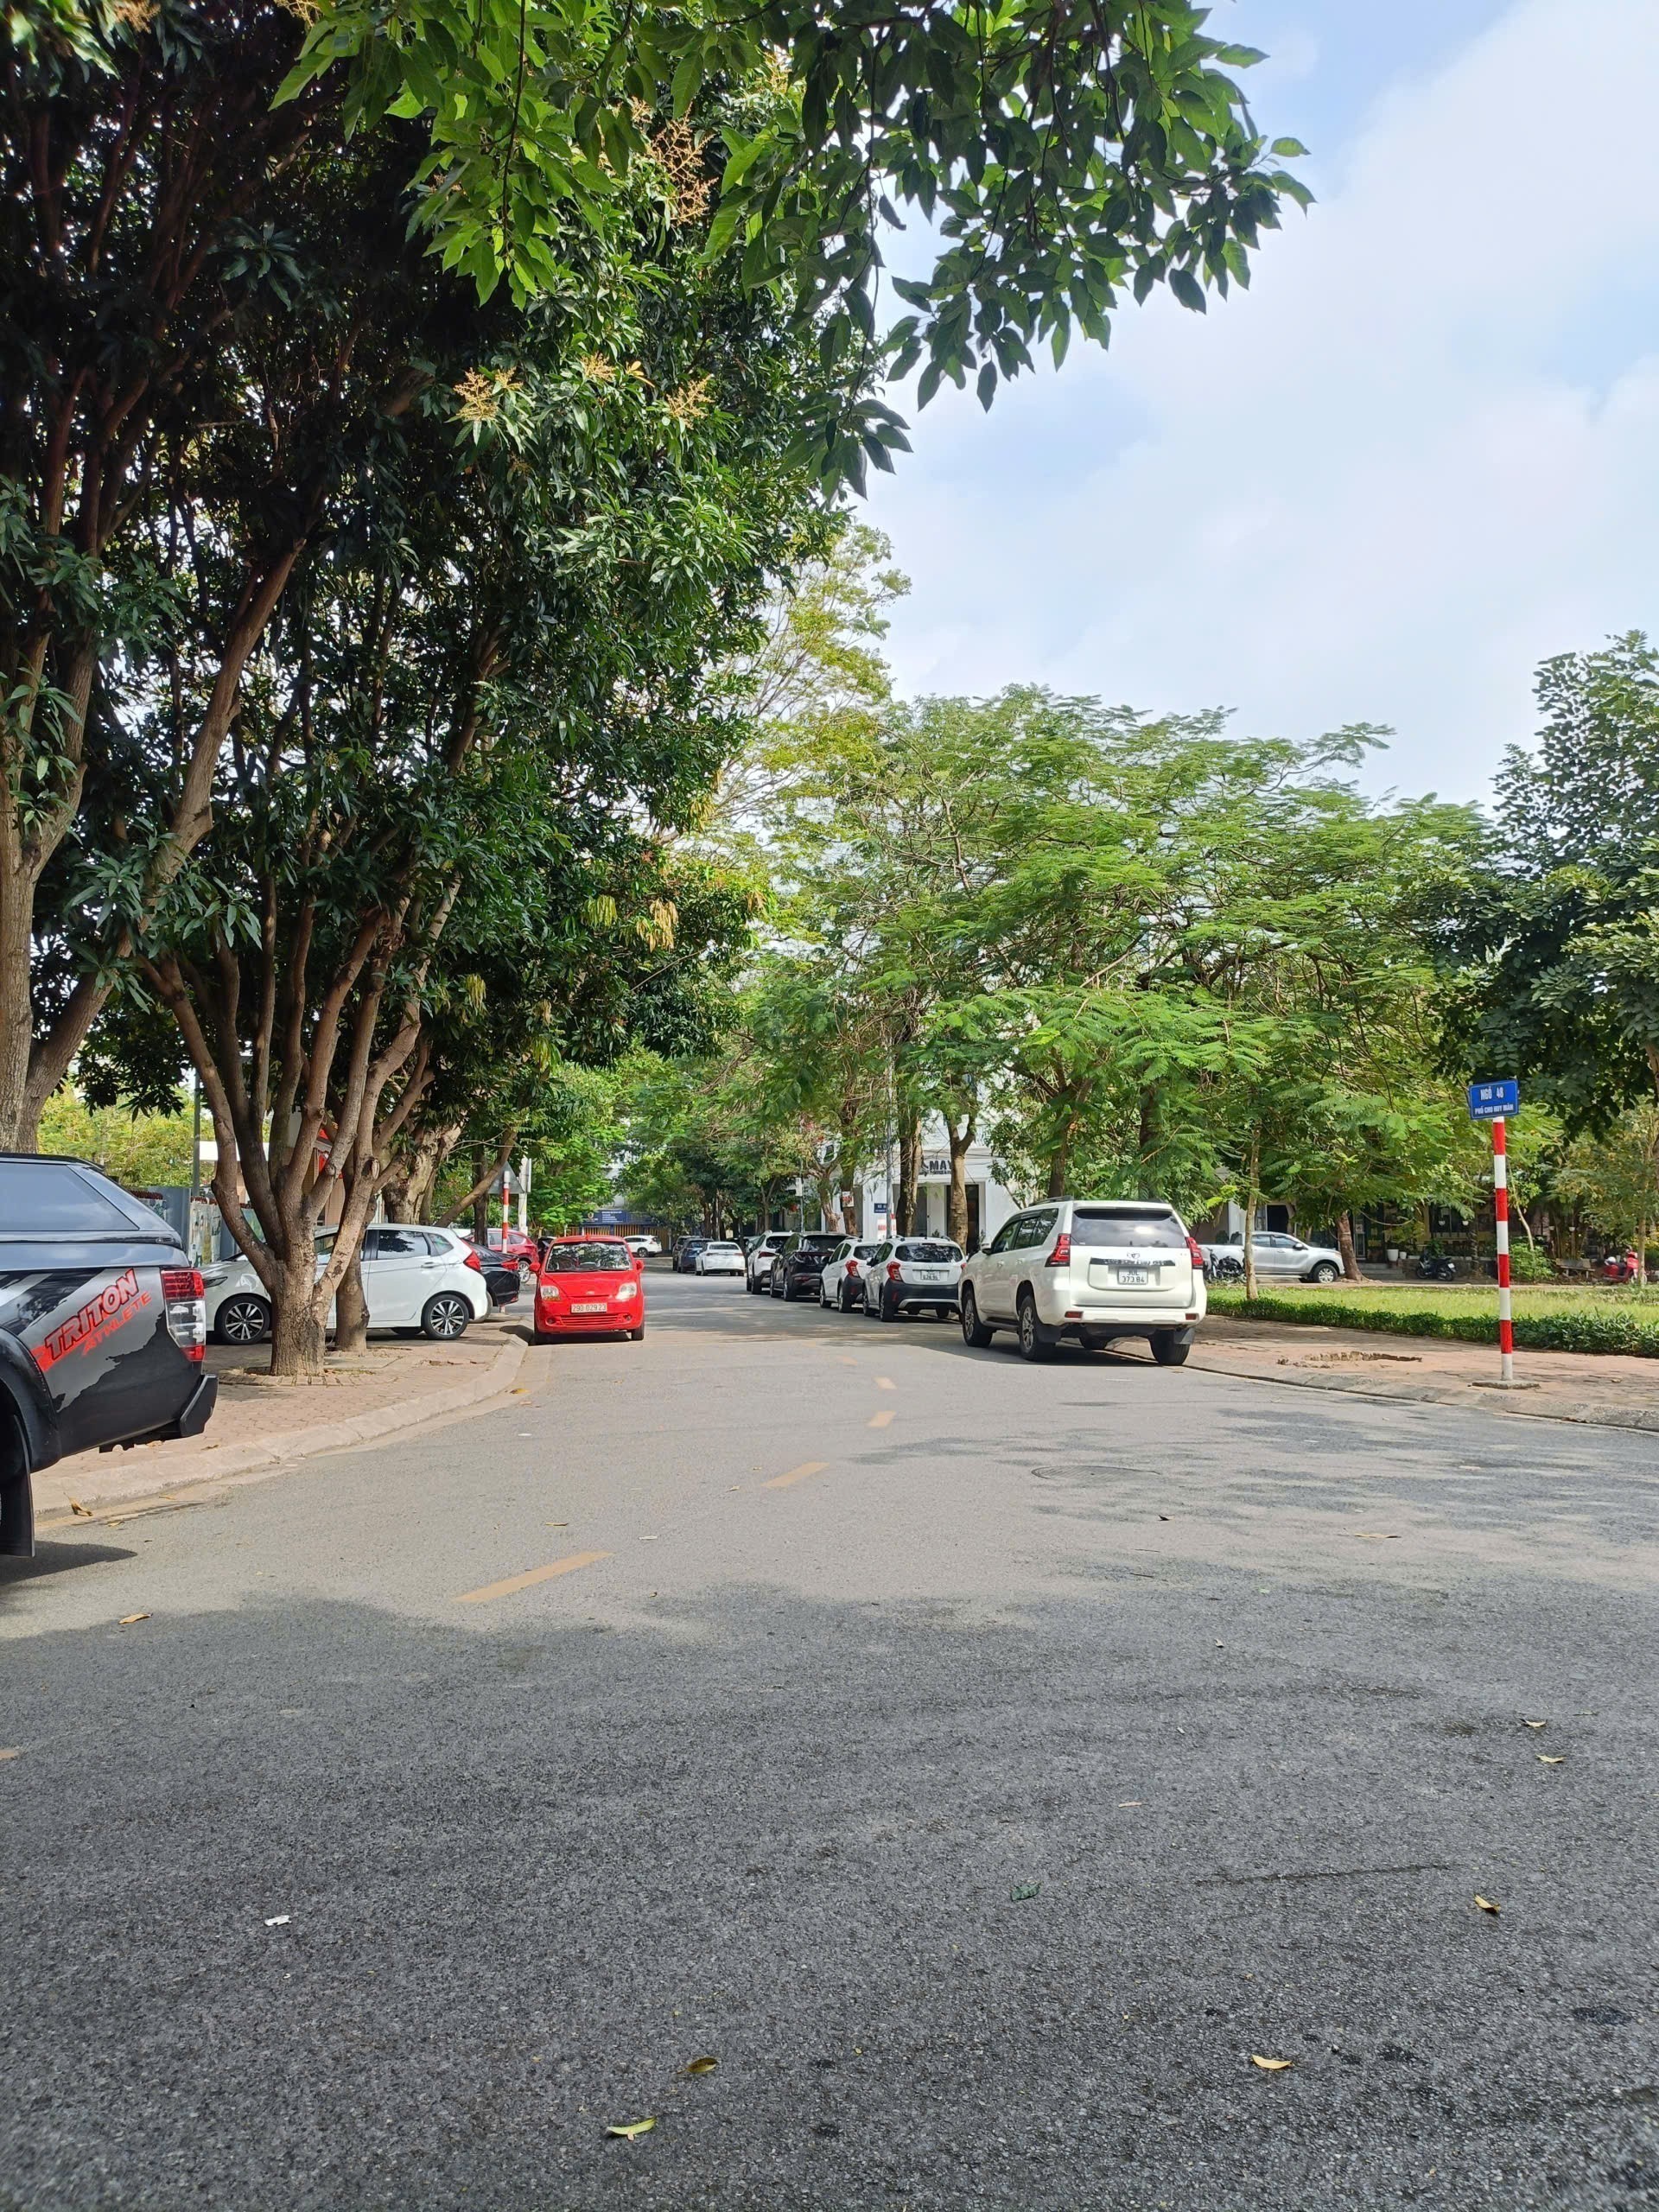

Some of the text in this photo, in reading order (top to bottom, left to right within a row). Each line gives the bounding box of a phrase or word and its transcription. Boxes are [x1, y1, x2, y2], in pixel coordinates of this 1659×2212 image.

[1496, 1086, 1504, 1098] 48
[44, 1268, 138, 1360] TRITON
[81, 1291, 152, 1356] ATHLETE
